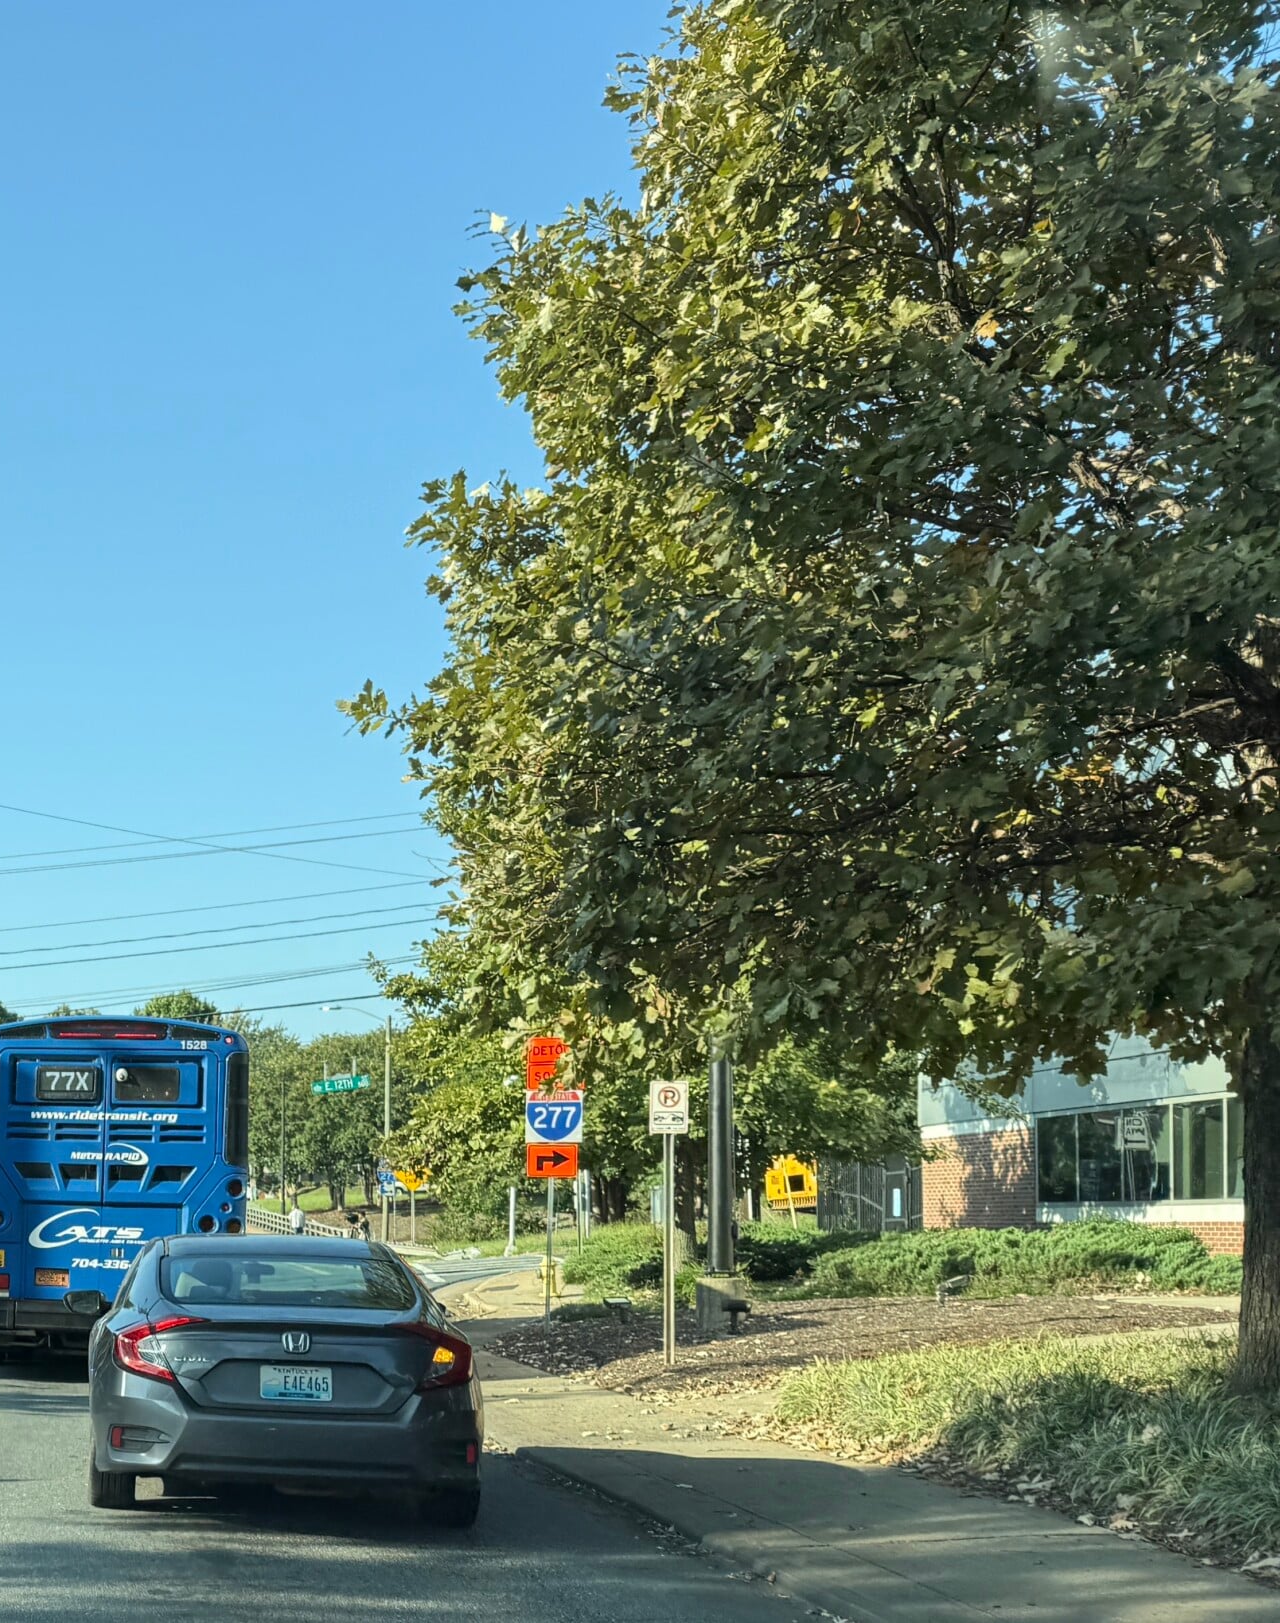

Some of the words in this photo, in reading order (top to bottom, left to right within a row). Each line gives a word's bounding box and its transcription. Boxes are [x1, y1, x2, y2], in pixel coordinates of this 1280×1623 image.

[180, 1040, 208, 1050] 1528
[533, 1045, 567, 1056] DETO
[46, 1071, 89, 1091] 77X
[334, 1078, 353, 1090] 12TH
[30, 1110, 178, 1124] www.ridetransit.org
[533, 1106, 576, 1129] 277
[28, 1208, 144, 1249] CATS
[283, 1375, 329, 1392] E4E465
